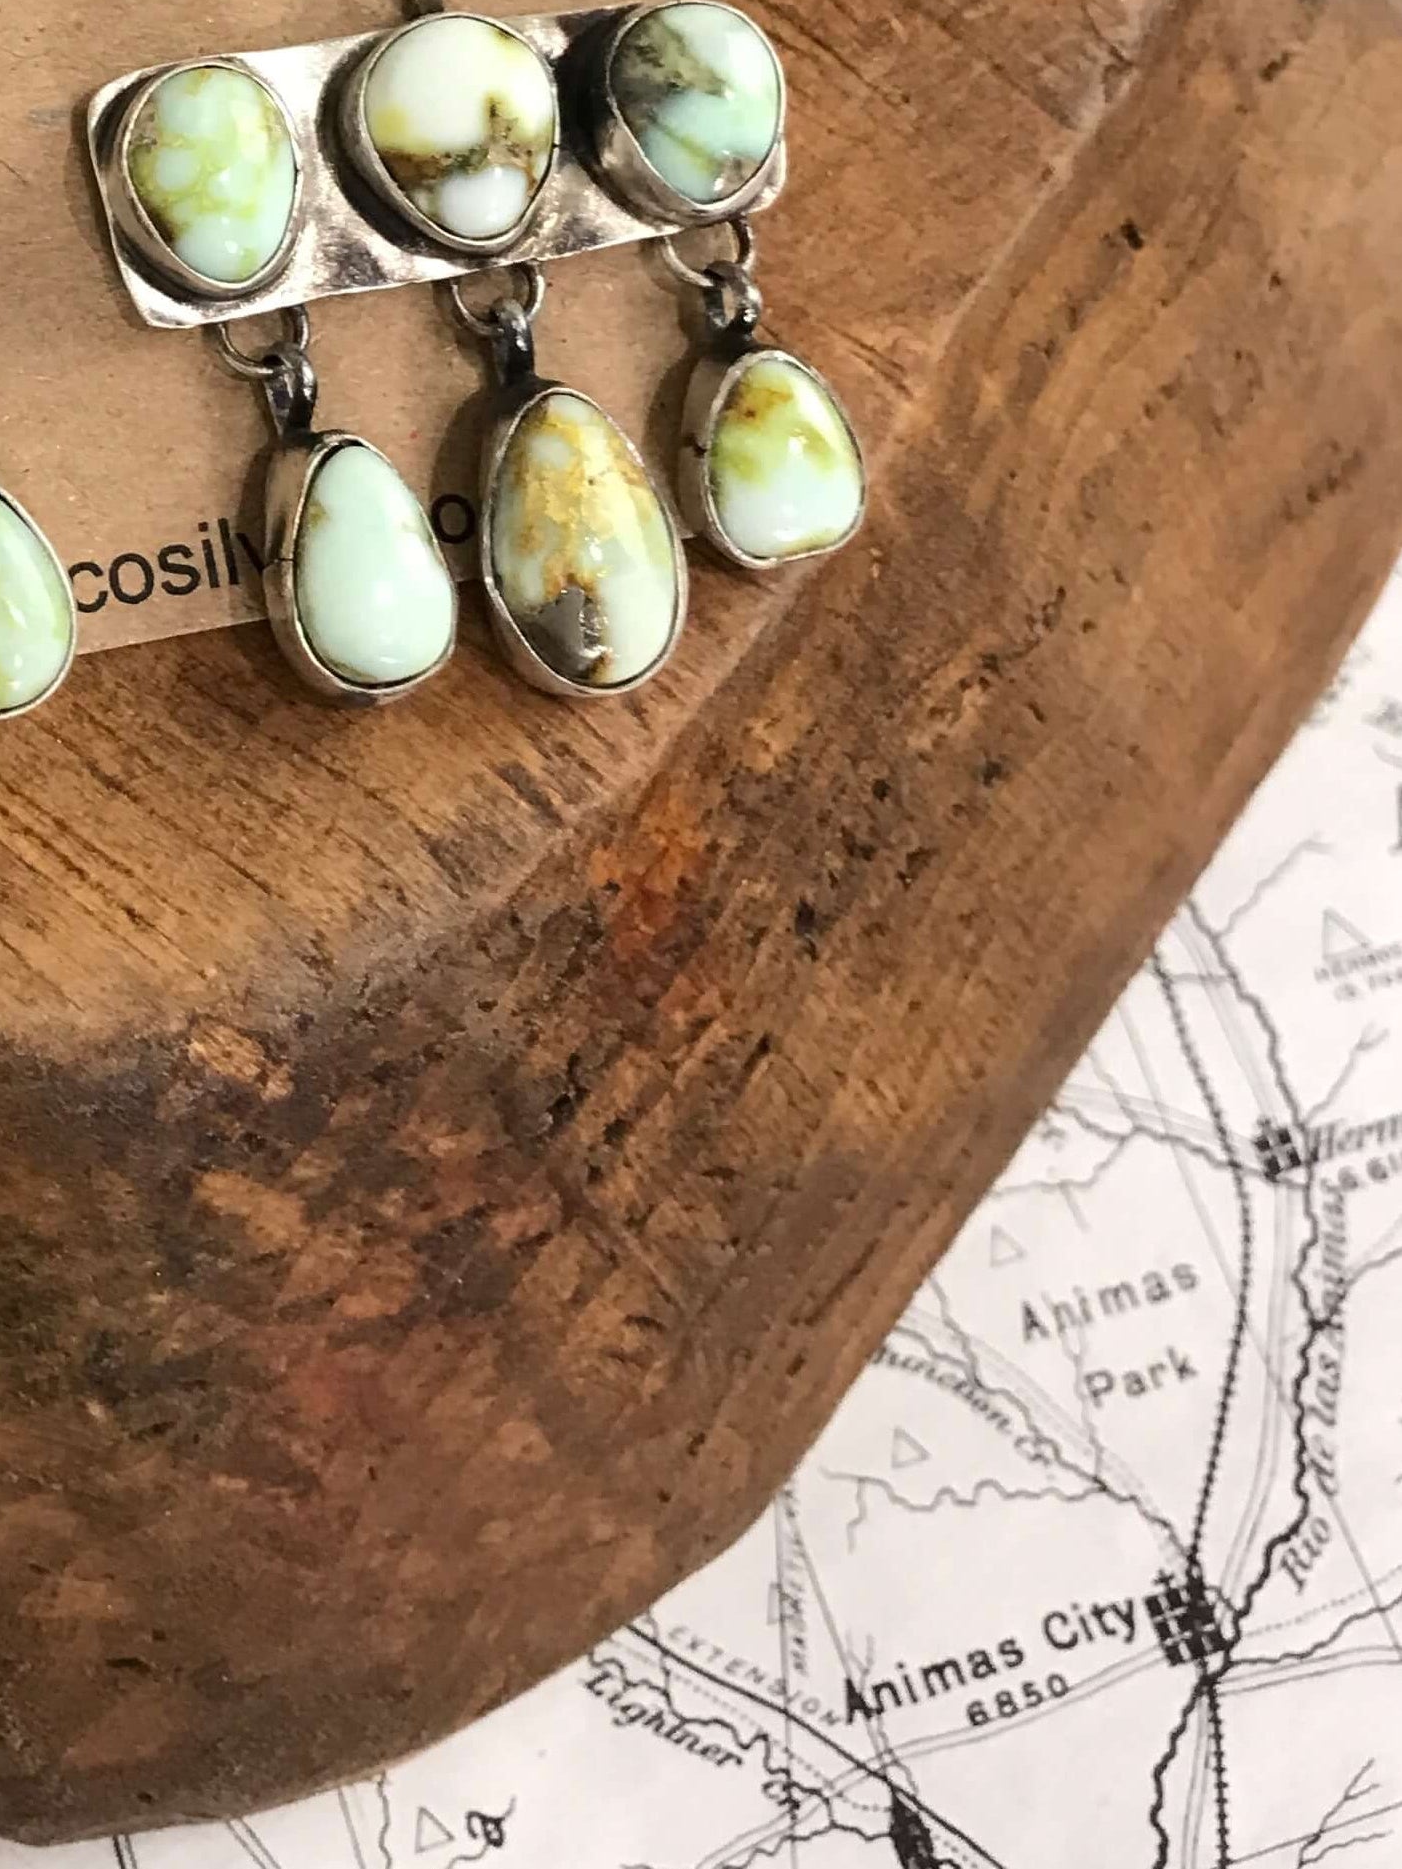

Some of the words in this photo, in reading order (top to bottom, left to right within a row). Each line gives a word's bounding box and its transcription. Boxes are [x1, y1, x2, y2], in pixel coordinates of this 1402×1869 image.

[1021, 1262, 1200, 1344] Animas
[1084, 1345, 1198, 1408] Park
[1280, 1517, 1330, 1593] Rio
[845, 1637, 1025, 1724] Animas
[1042, 1598, 1135, 1650] City
[965, 1672, 1070, 1727] 6850
[582, 1670, 744, 1767] Lightner
